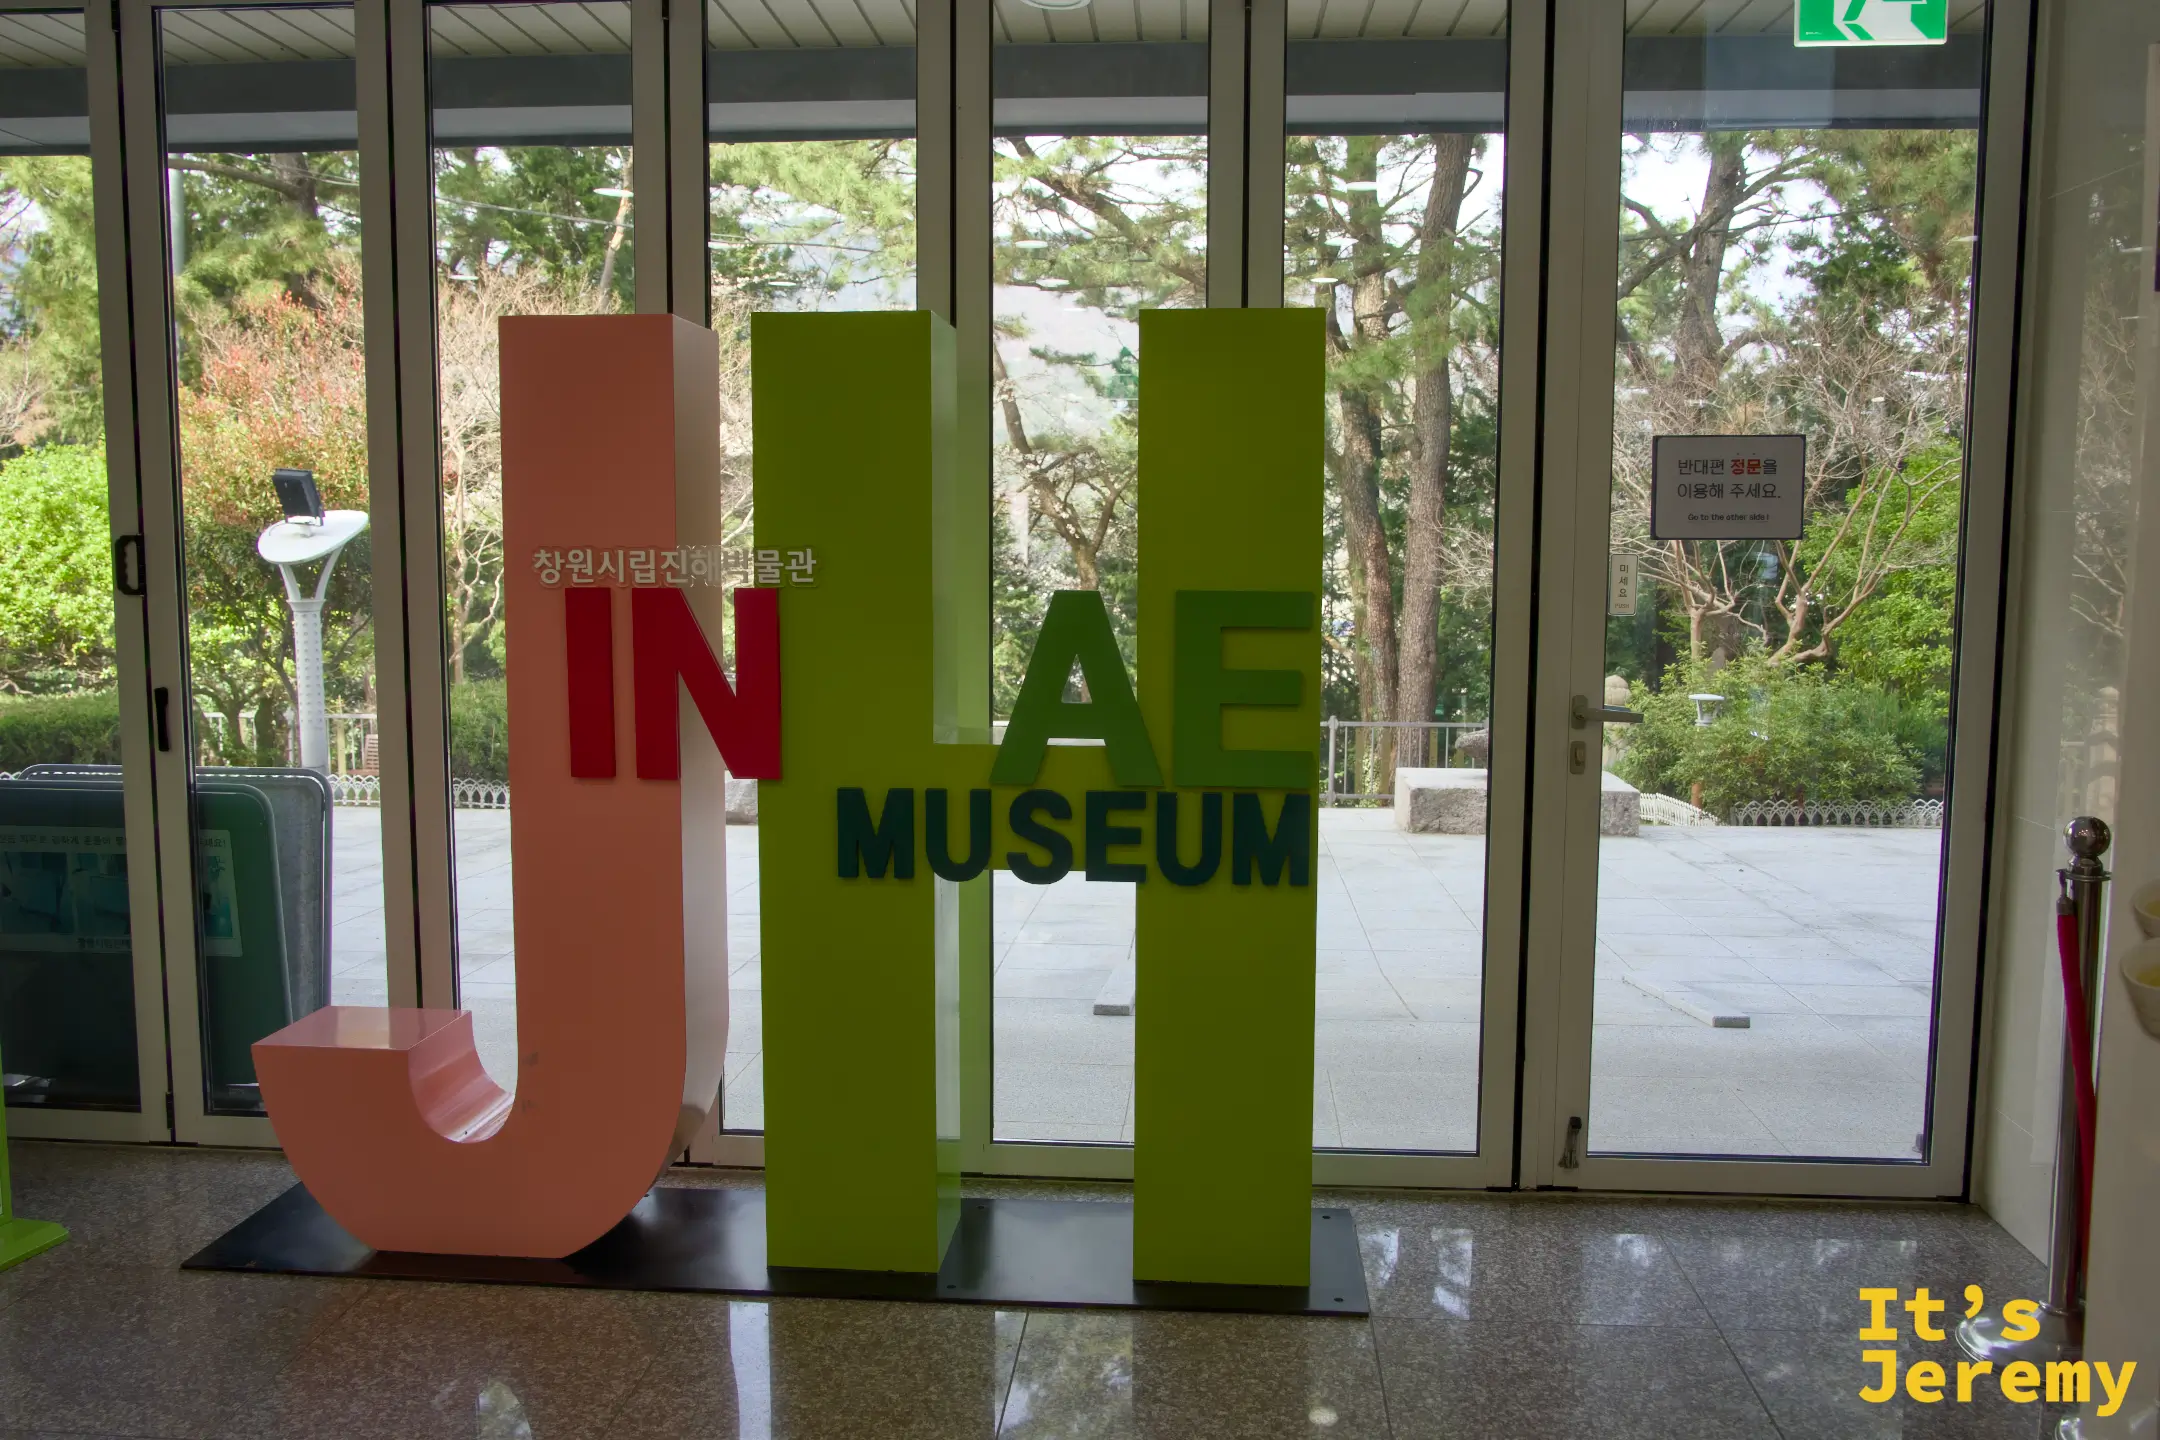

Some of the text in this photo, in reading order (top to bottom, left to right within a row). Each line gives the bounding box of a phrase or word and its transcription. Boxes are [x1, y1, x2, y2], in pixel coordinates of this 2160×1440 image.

[1677, 482, 1781, 499] 이용해 주세요.
[1678, 458, 1777, 475] 반대편 정문을
[1688, 513, 1699, 521] Go
[1700, 513, 1709, 521] to
[1711, 513, 1724, 521] the
[1726, 513, 1748, 521] other
[565, 587, 782, 779] IN
[989, 590, 1314, 788] AE
[837, 787, 1312, 887] MUSEUM
